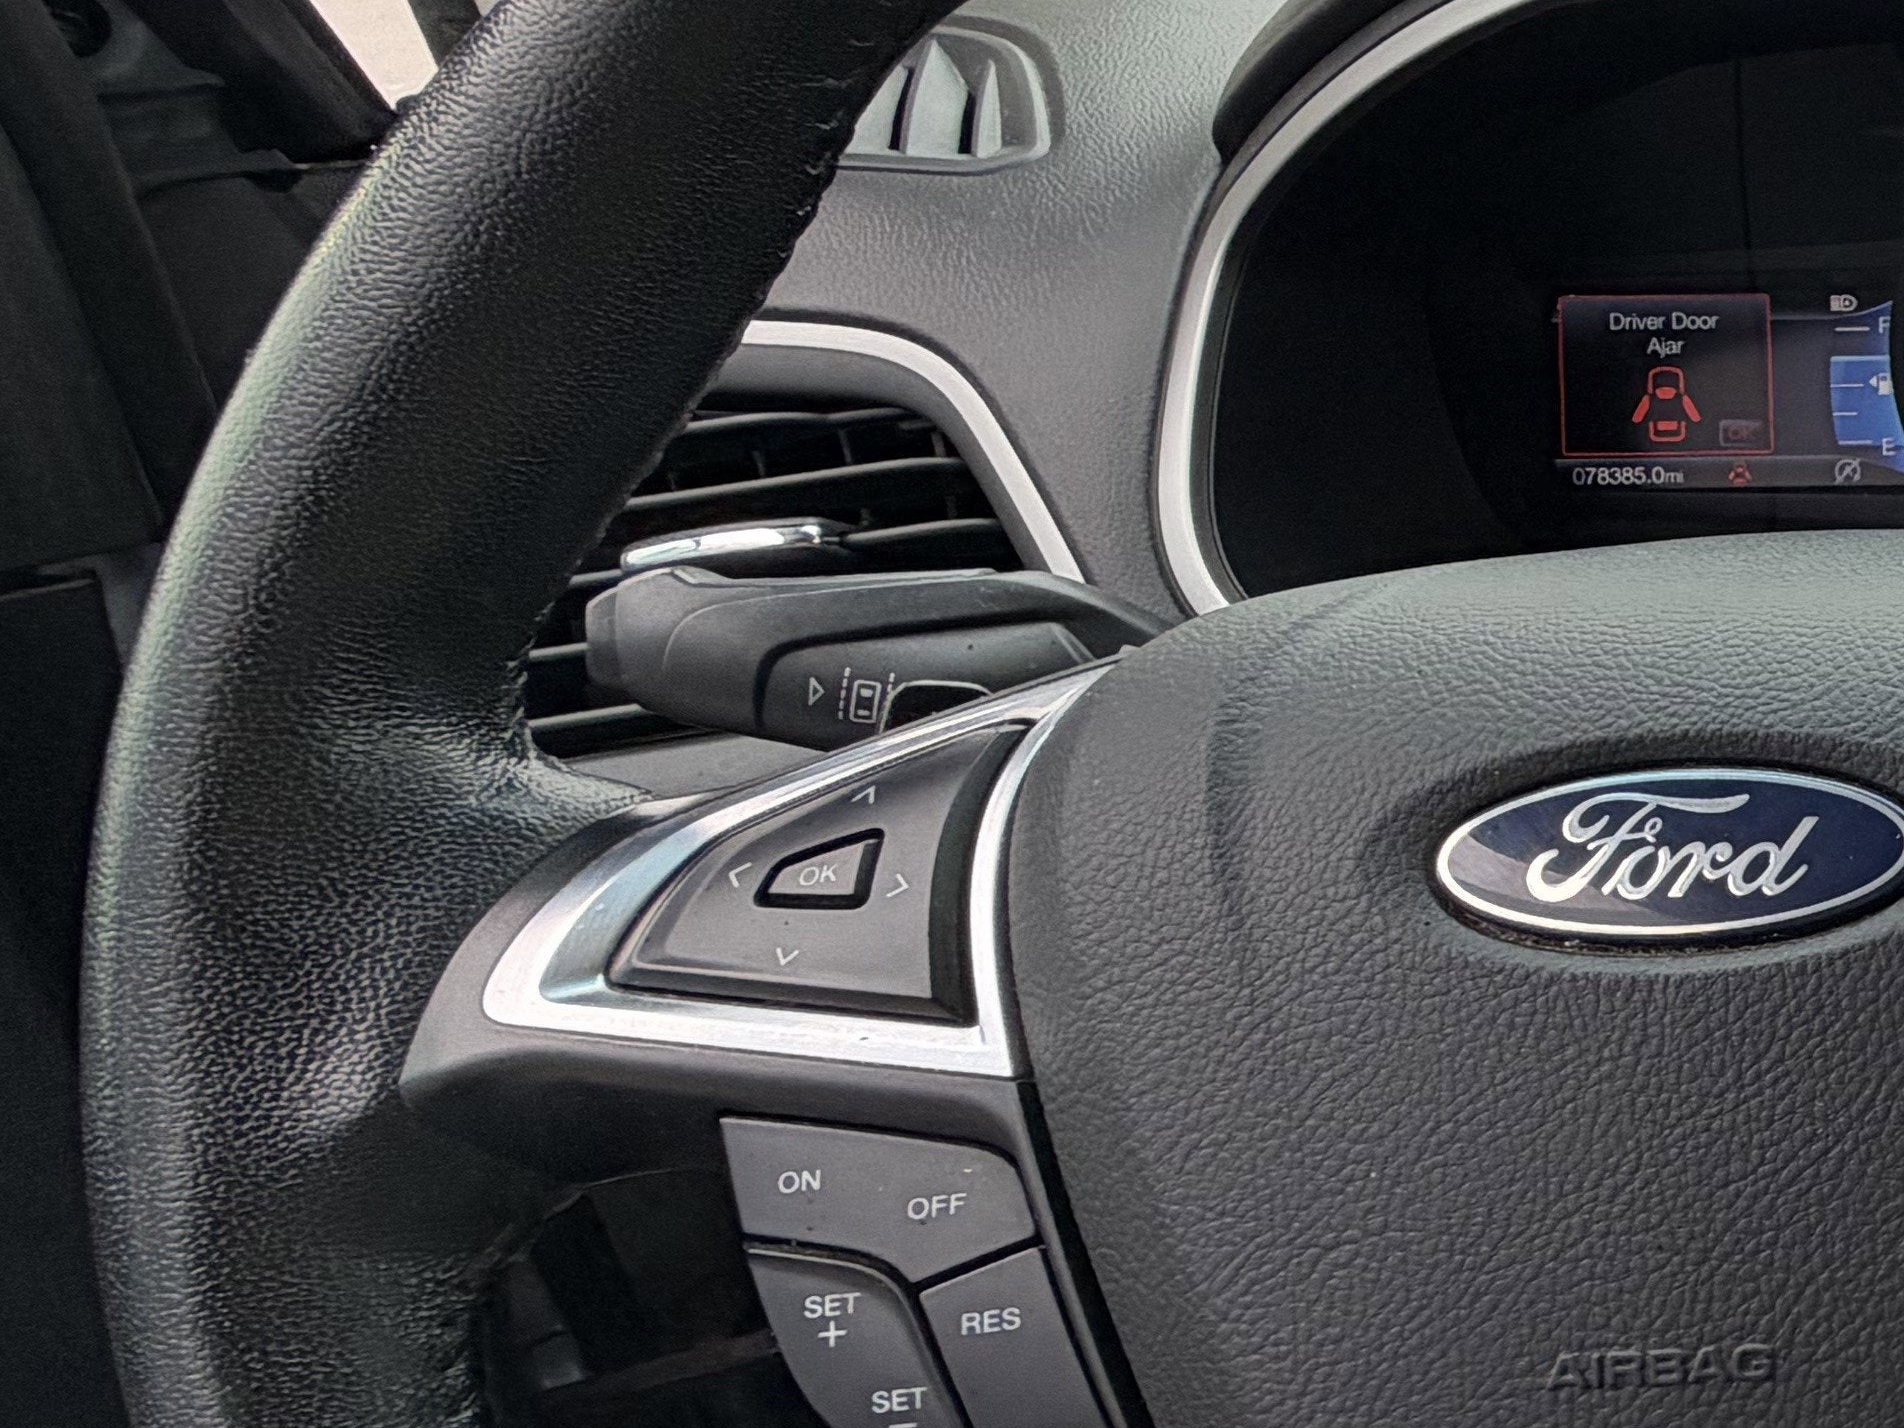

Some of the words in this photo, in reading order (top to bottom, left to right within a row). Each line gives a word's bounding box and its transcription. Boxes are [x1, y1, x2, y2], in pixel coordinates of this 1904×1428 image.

[1609, 312, 1665, 331] Driver
[1672, 312, 1719, 331] Door
[1878, 316, 1891, 334] F
[1647, 337, 1685, 358] Ajar
[1881, 438, 1895, 456] E
[1526, 792, 1820, 903] Ford
[798, 865, 838, 886] OK
[777, 1169, 822, 1194] ON
[907, 1192, 968, 1220] OFF
[803, 1292, 860, 1319] SET
[960, 1307, 1022, 1336] RES
[1548, 1342, 1776, 1390] AIRBAG
[871, 1387, 928, 1414] SET
